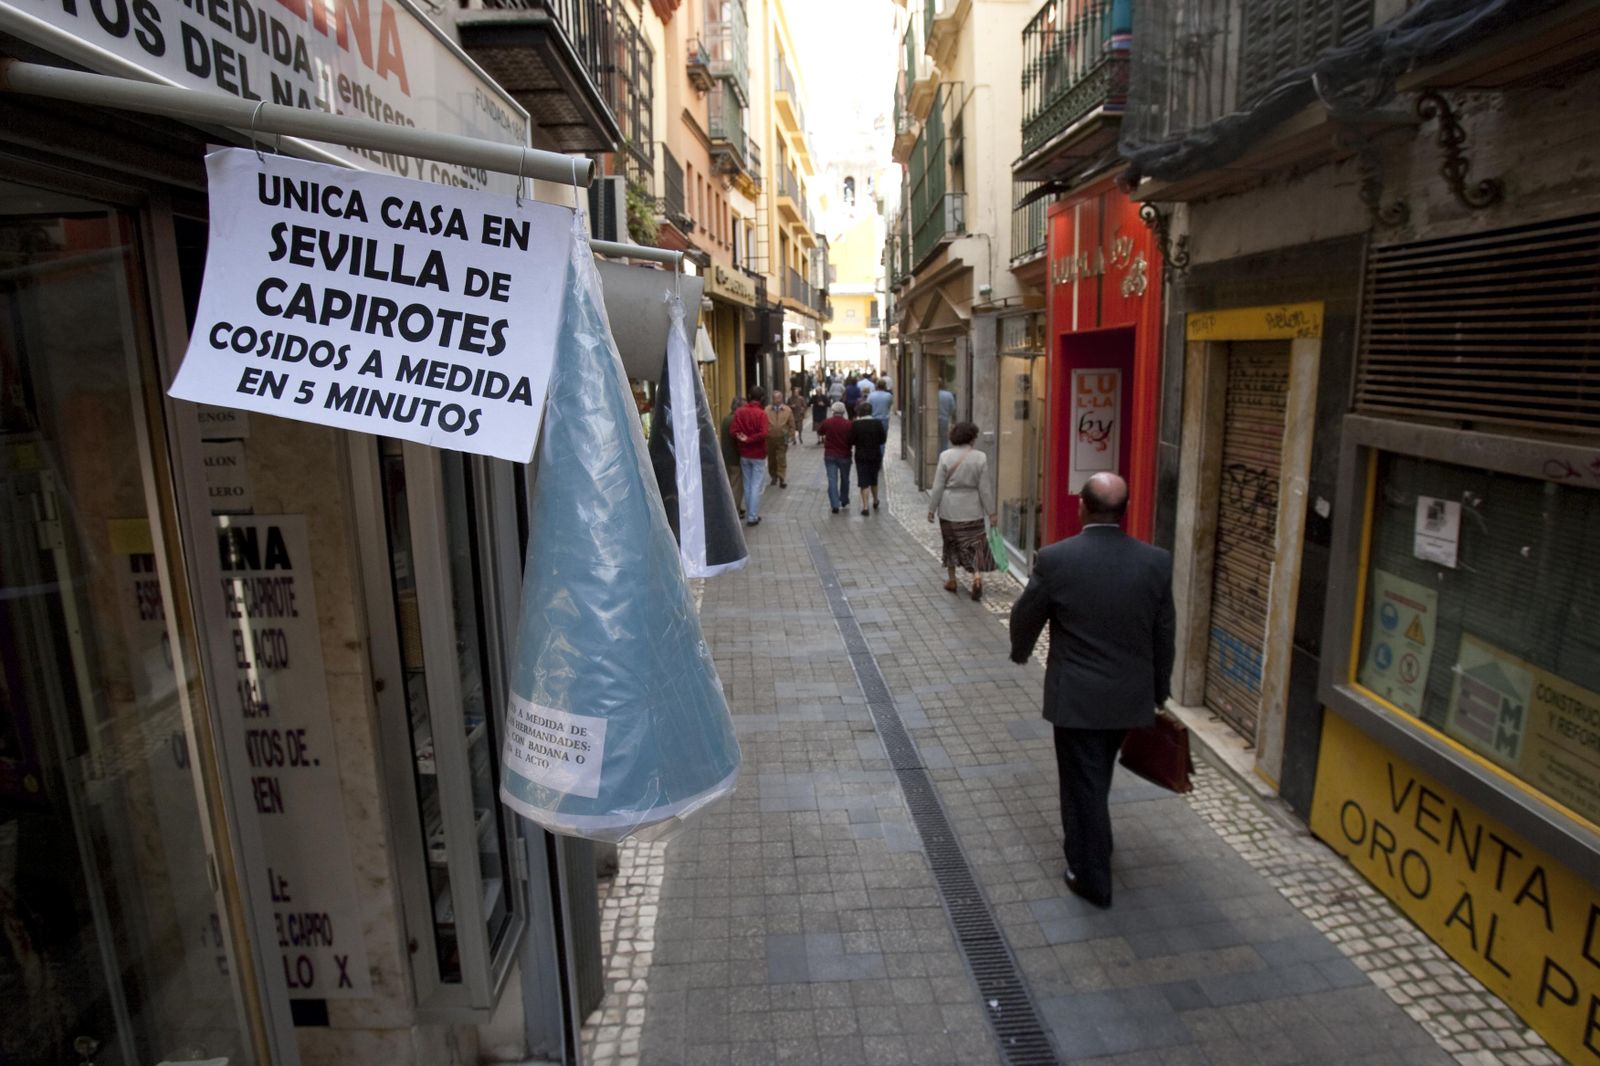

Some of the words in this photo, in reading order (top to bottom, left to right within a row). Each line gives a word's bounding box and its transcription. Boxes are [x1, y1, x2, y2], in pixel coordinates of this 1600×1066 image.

[61, 0, 166, 57] OS
[180, 20, 262, 101] DEL
[257, 172, 368, 223] UNICA
[380, 196, 469, 241] CASA
[480, 212, 531, 252] EN
[267, 221, 450, 292] SEVILLA
[463, 266, 512, 303] DE
[255, 276, 510, 357] CAPIROTES
[208, 321, 351, 371] COSIDOS
[357, 348, 383, 379] A
[394, 355, 534, 406] MEDIDA
[1078, 375, 1117, 394] LU
[236, 366, 289, 400] EN
[293, 380, 316, 405] 5
[323, 382, 482, 436] MINUTOS
[1078, 410, 1113, 442] by
[511, 731, 525, 746] CON
[528, 740, 570, 762] BADANA
[575, 755, 586, 765] O
[515, 720, 591, 752] HERMANDADES:
[525, 712, 564, 732] MEDIDA
[570, 725, 587, 737] DE
[525, 753, 550, 769] ACTO
[1387, 762, 1553, 931] VENTA
[1340, 800, 1432, 899] ORO
[1444, 892, 1510, 978] AL
[334, 955, 353, 988] X
